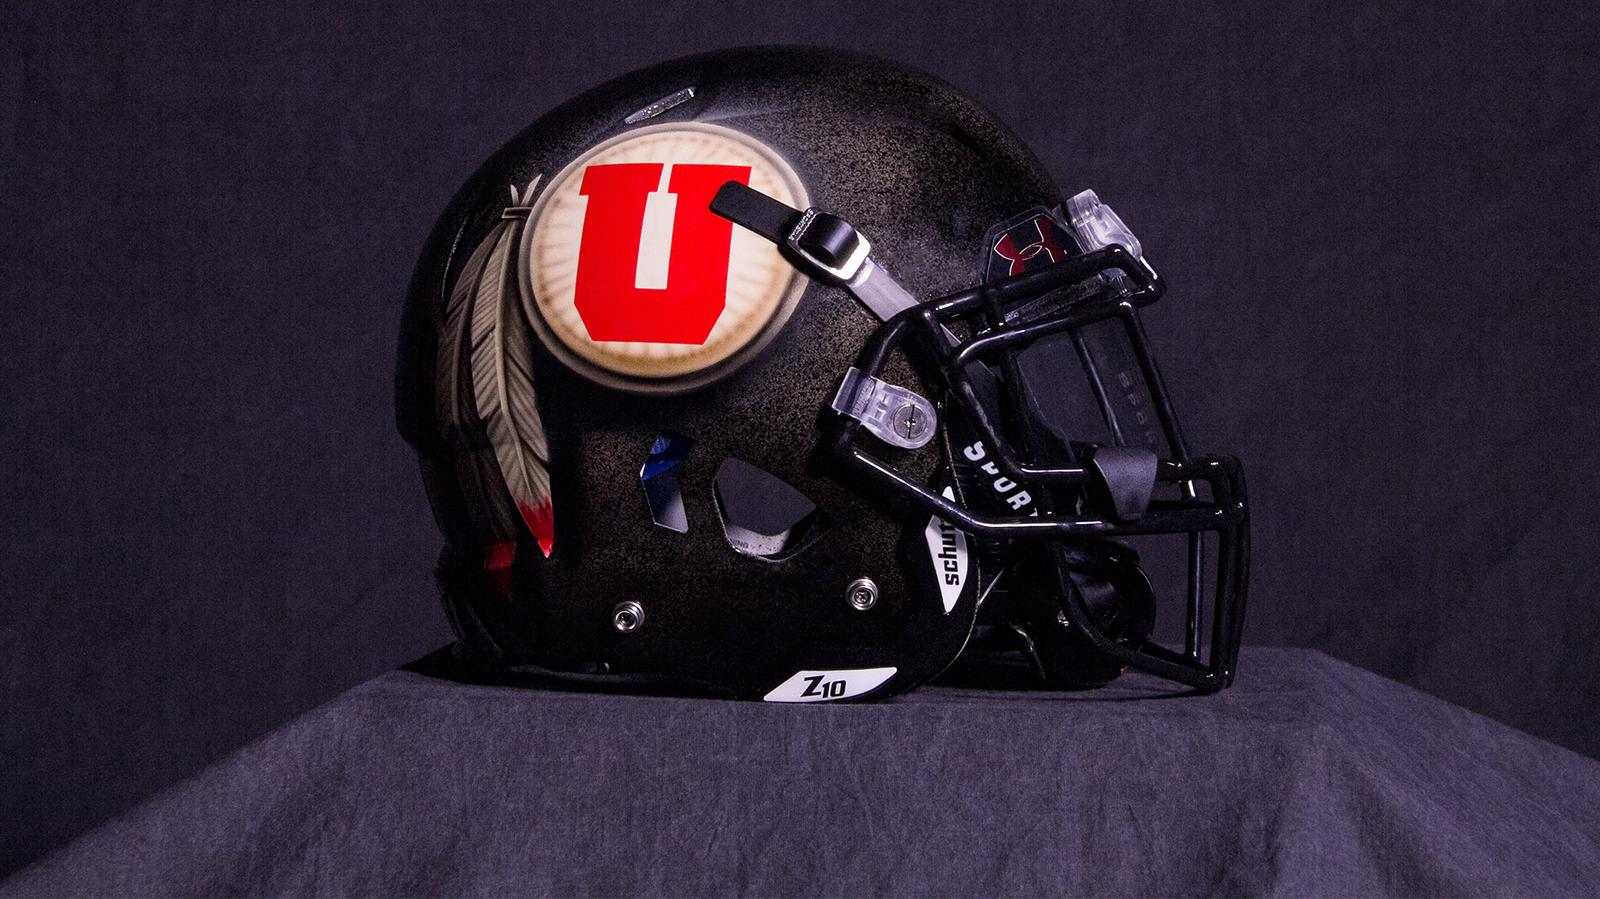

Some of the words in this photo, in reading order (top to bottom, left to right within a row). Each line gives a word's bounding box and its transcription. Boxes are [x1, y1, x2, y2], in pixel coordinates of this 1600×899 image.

[574, 163, 751, 345] U
[938, 520, 959, 586] schut
[800, 675, 846, 699] Z10
